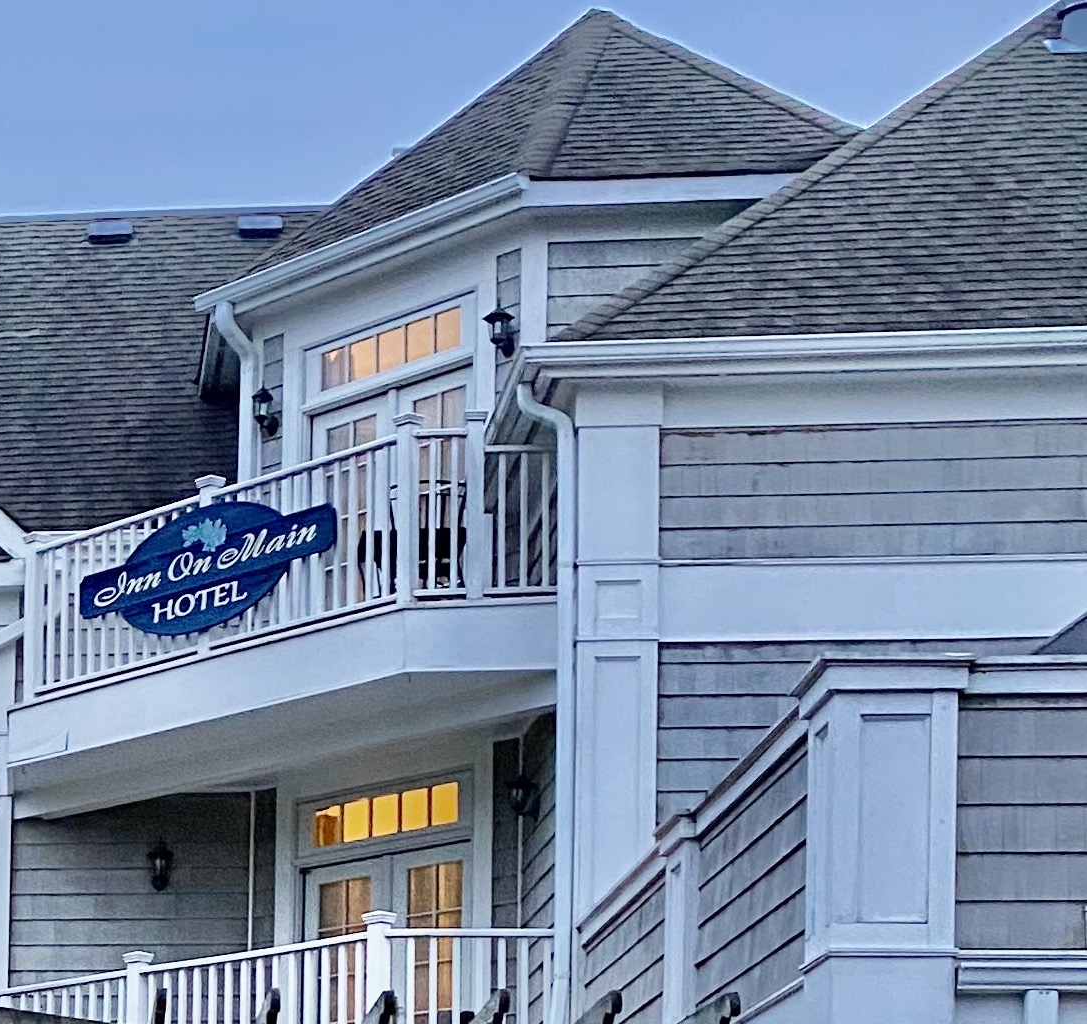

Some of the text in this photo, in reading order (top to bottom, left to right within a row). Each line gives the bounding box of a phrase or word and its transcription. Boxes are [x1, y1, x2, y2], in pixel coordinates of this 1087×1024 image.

[93, 523, 317, 607] Inn On Main
[152, 581, 248, 623] HOTEL
